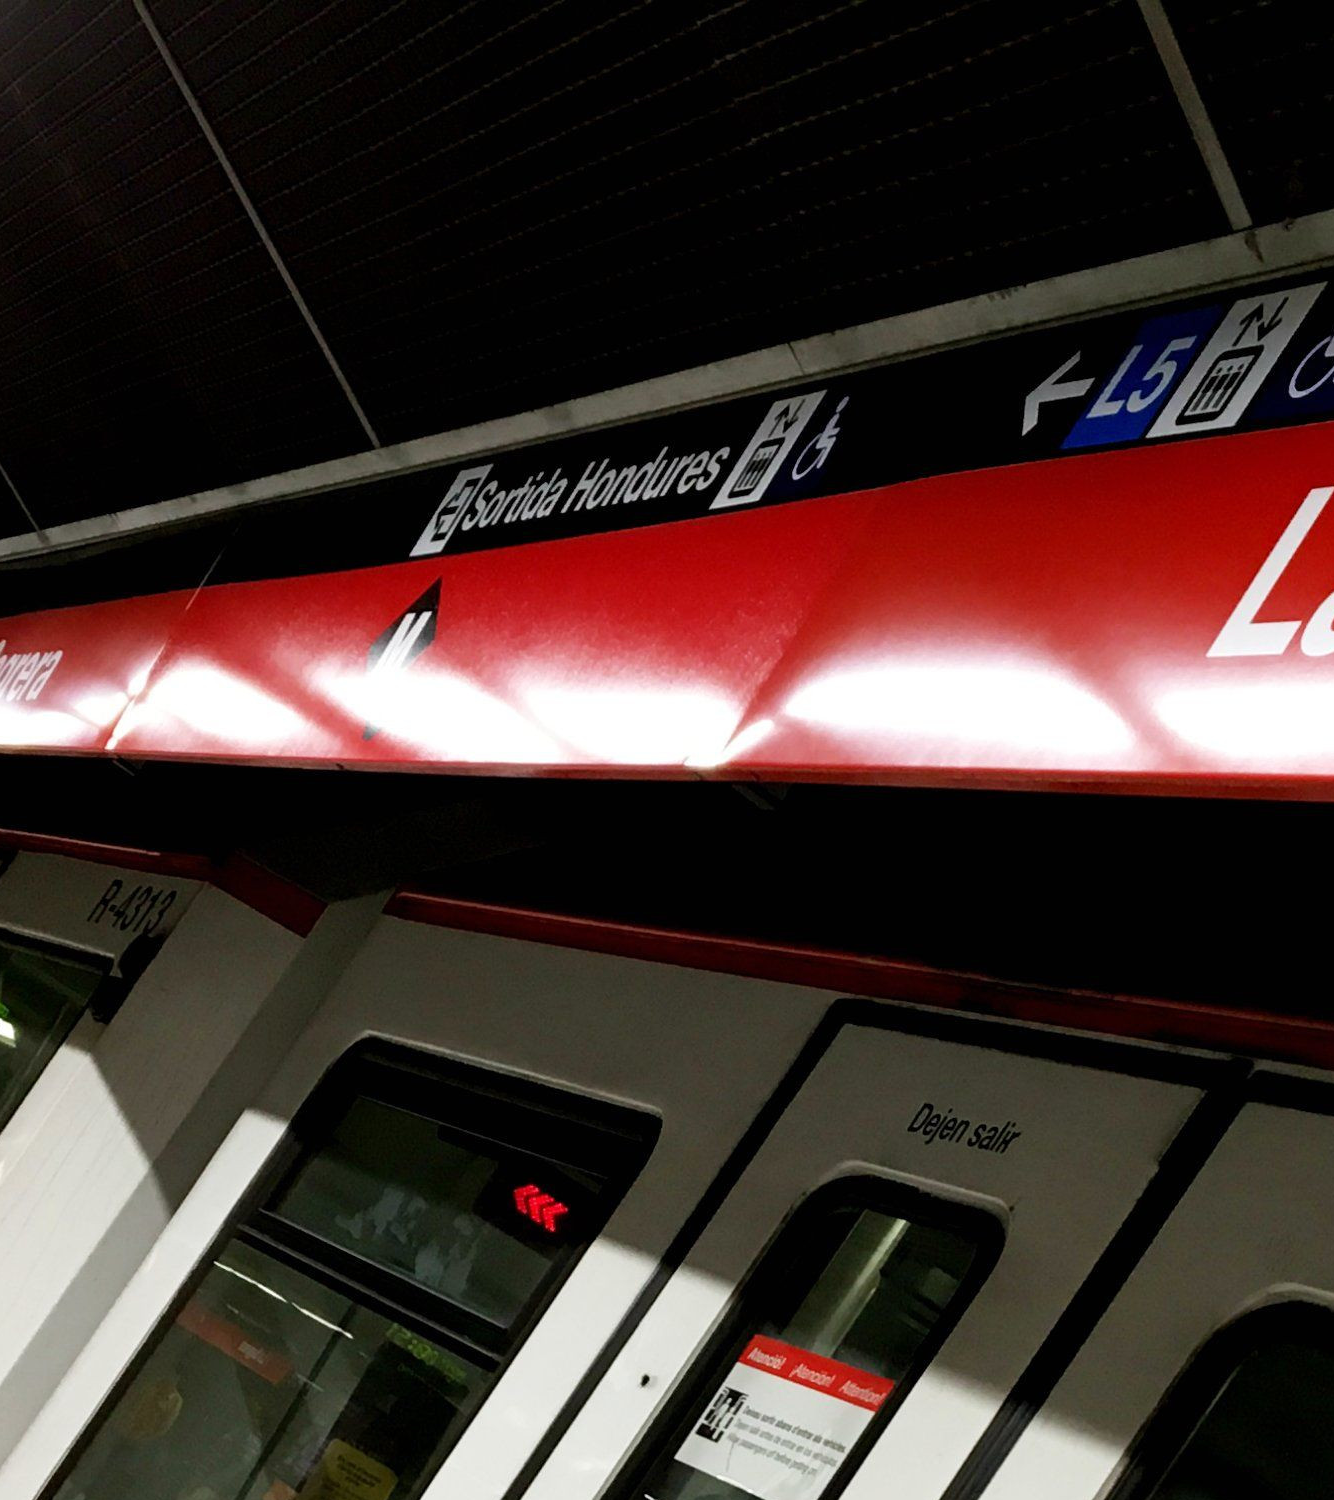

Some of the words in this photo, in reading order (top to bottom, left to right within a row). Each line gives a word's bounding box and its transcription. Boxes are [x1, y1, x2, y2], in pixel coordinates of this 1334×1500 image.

[1085, 335, 1198, 418] L5
[461, 467, 568, 531] Sortida
[561, 446, 730, 513] Hondures
[87, 879, 177, 936] R-4313
[907, 1103, 970, 1145] Dejen
[967, 1121, 1021, 1154] salir
